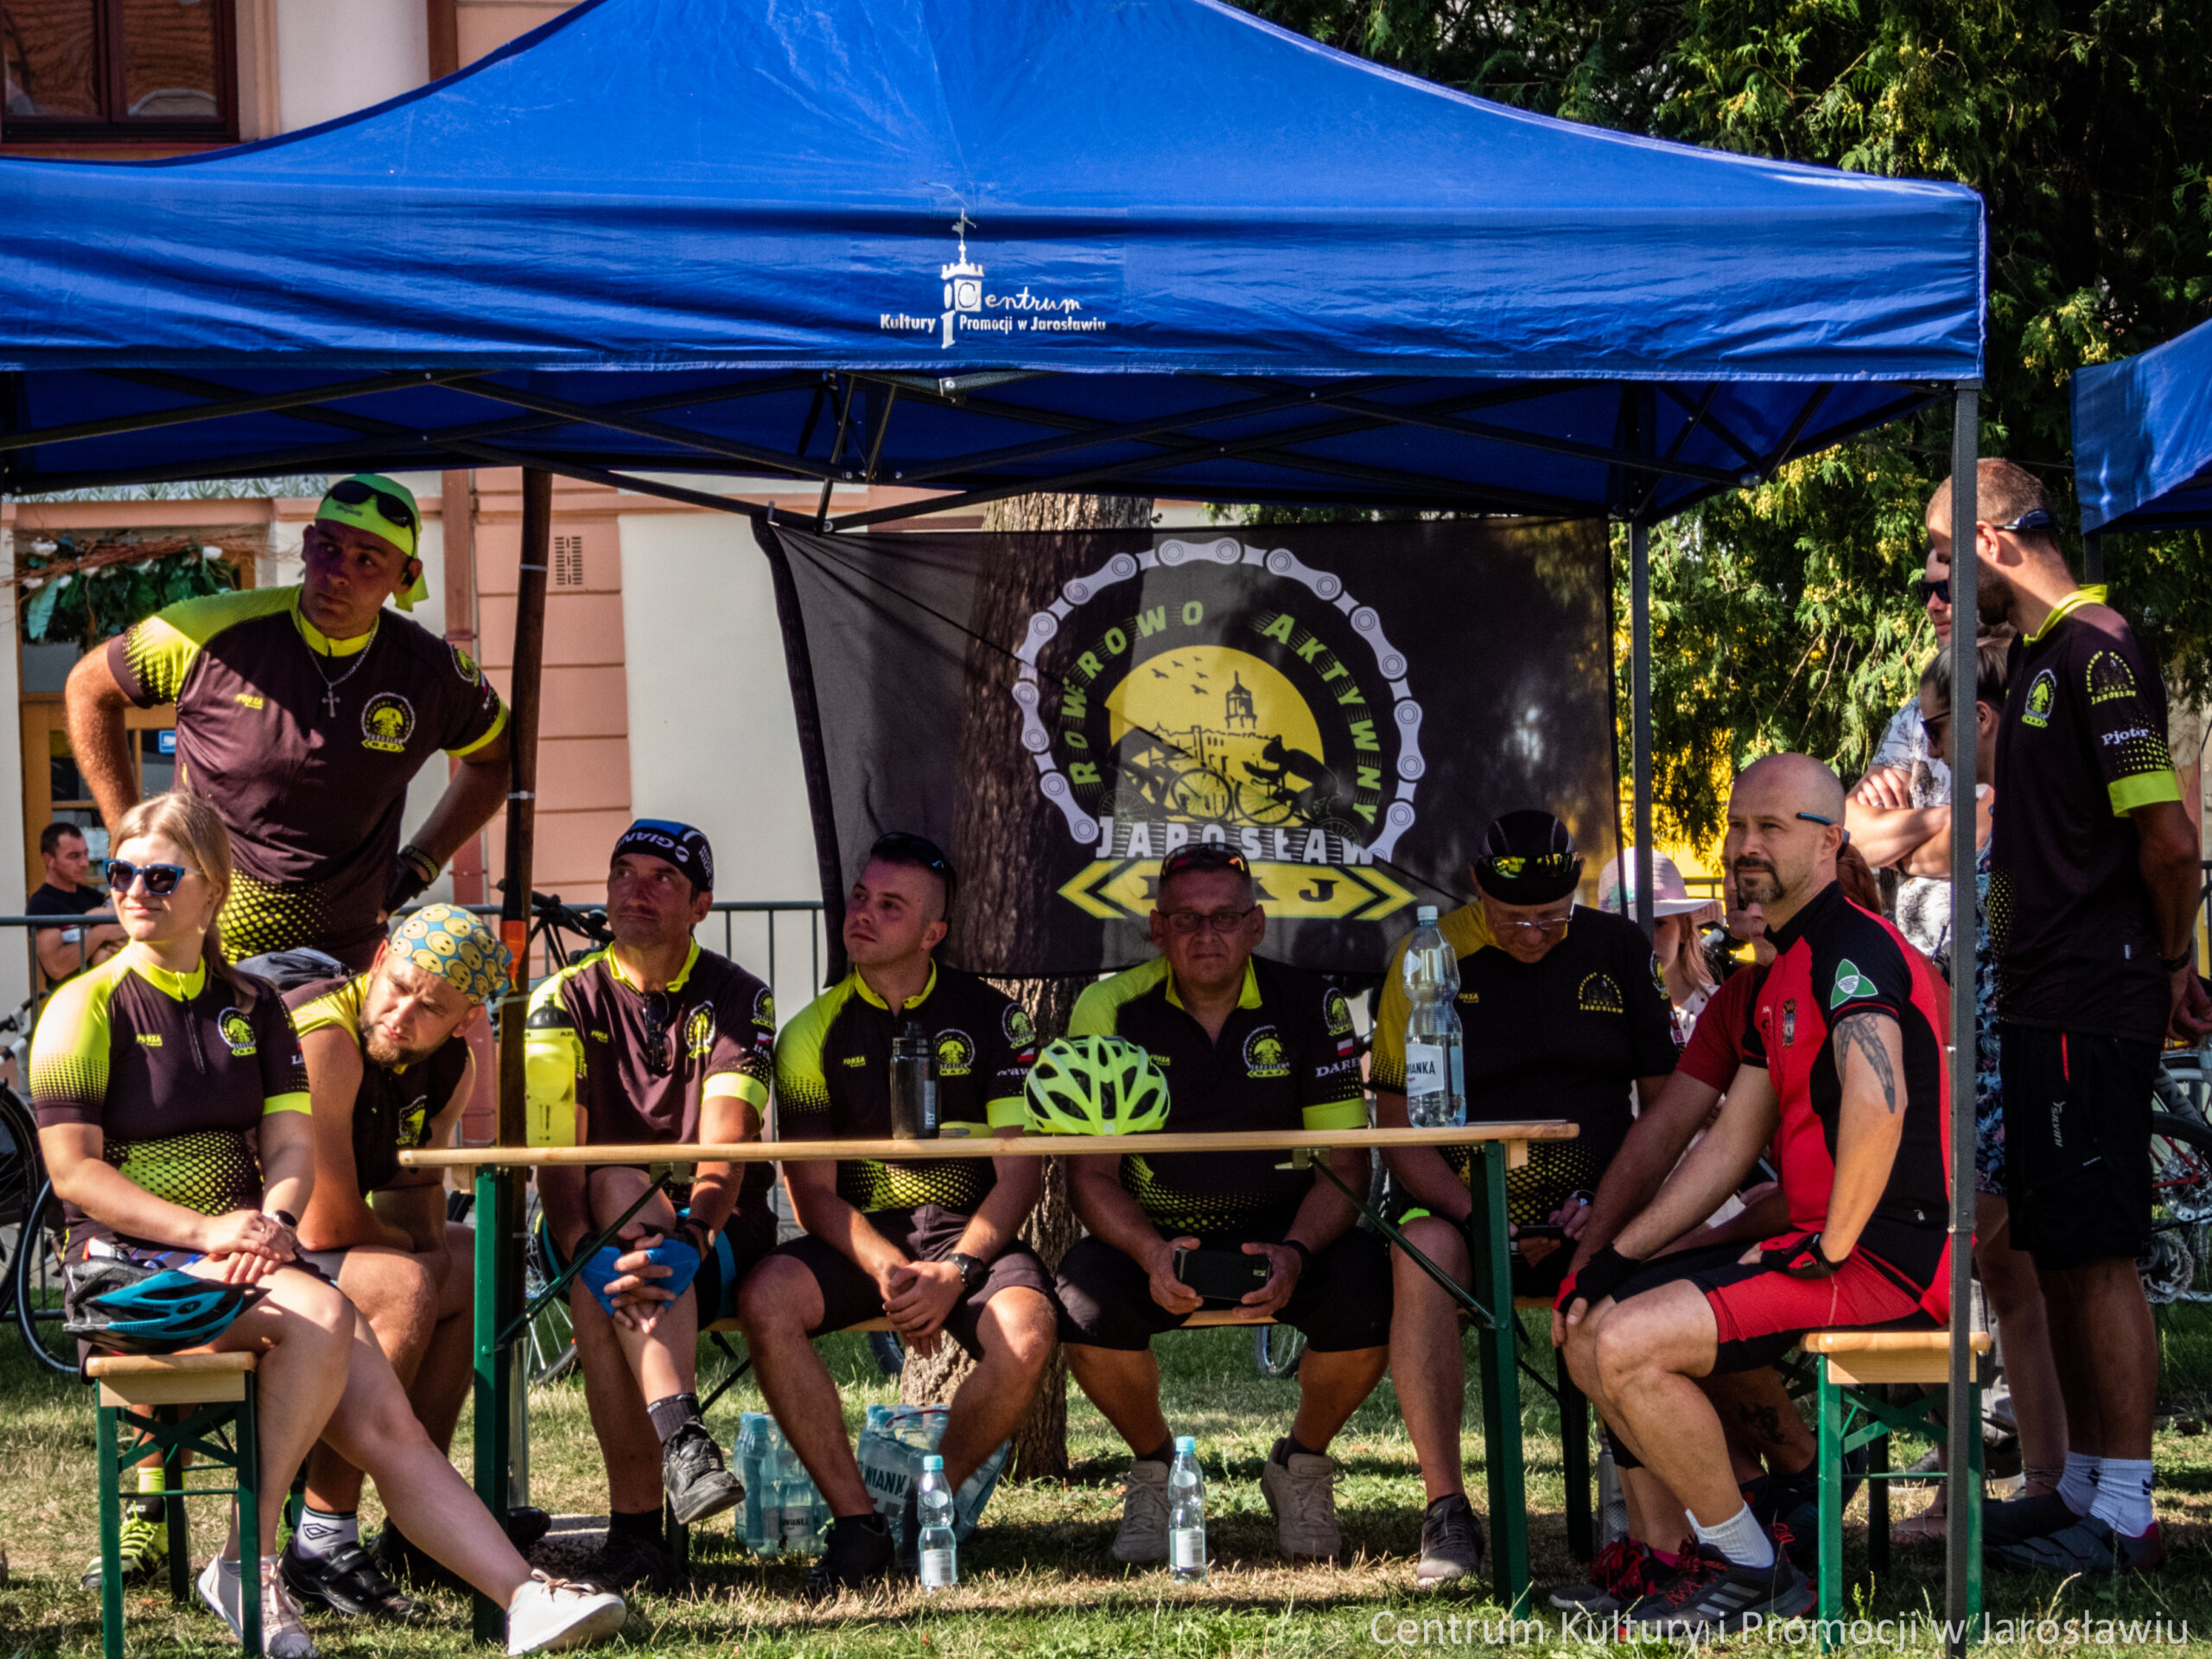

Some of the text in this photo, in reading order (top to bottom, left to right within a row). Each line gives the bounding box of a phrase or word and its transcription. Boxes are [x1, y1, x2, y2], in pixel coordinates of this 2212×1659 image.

[880, 313, 936, 334] Kultury
[959, 315, 1013, 334] Promocji
[1018, 319, 1030, 331] w
[1030, 316, 1107, 331] Jarosławiu
[1061, 600, 1382, 825] ROWEROWO AKTYWNY
[614, 831, 675, 852] GIAN
[1315, 1056, 1362, 1078] DARE
